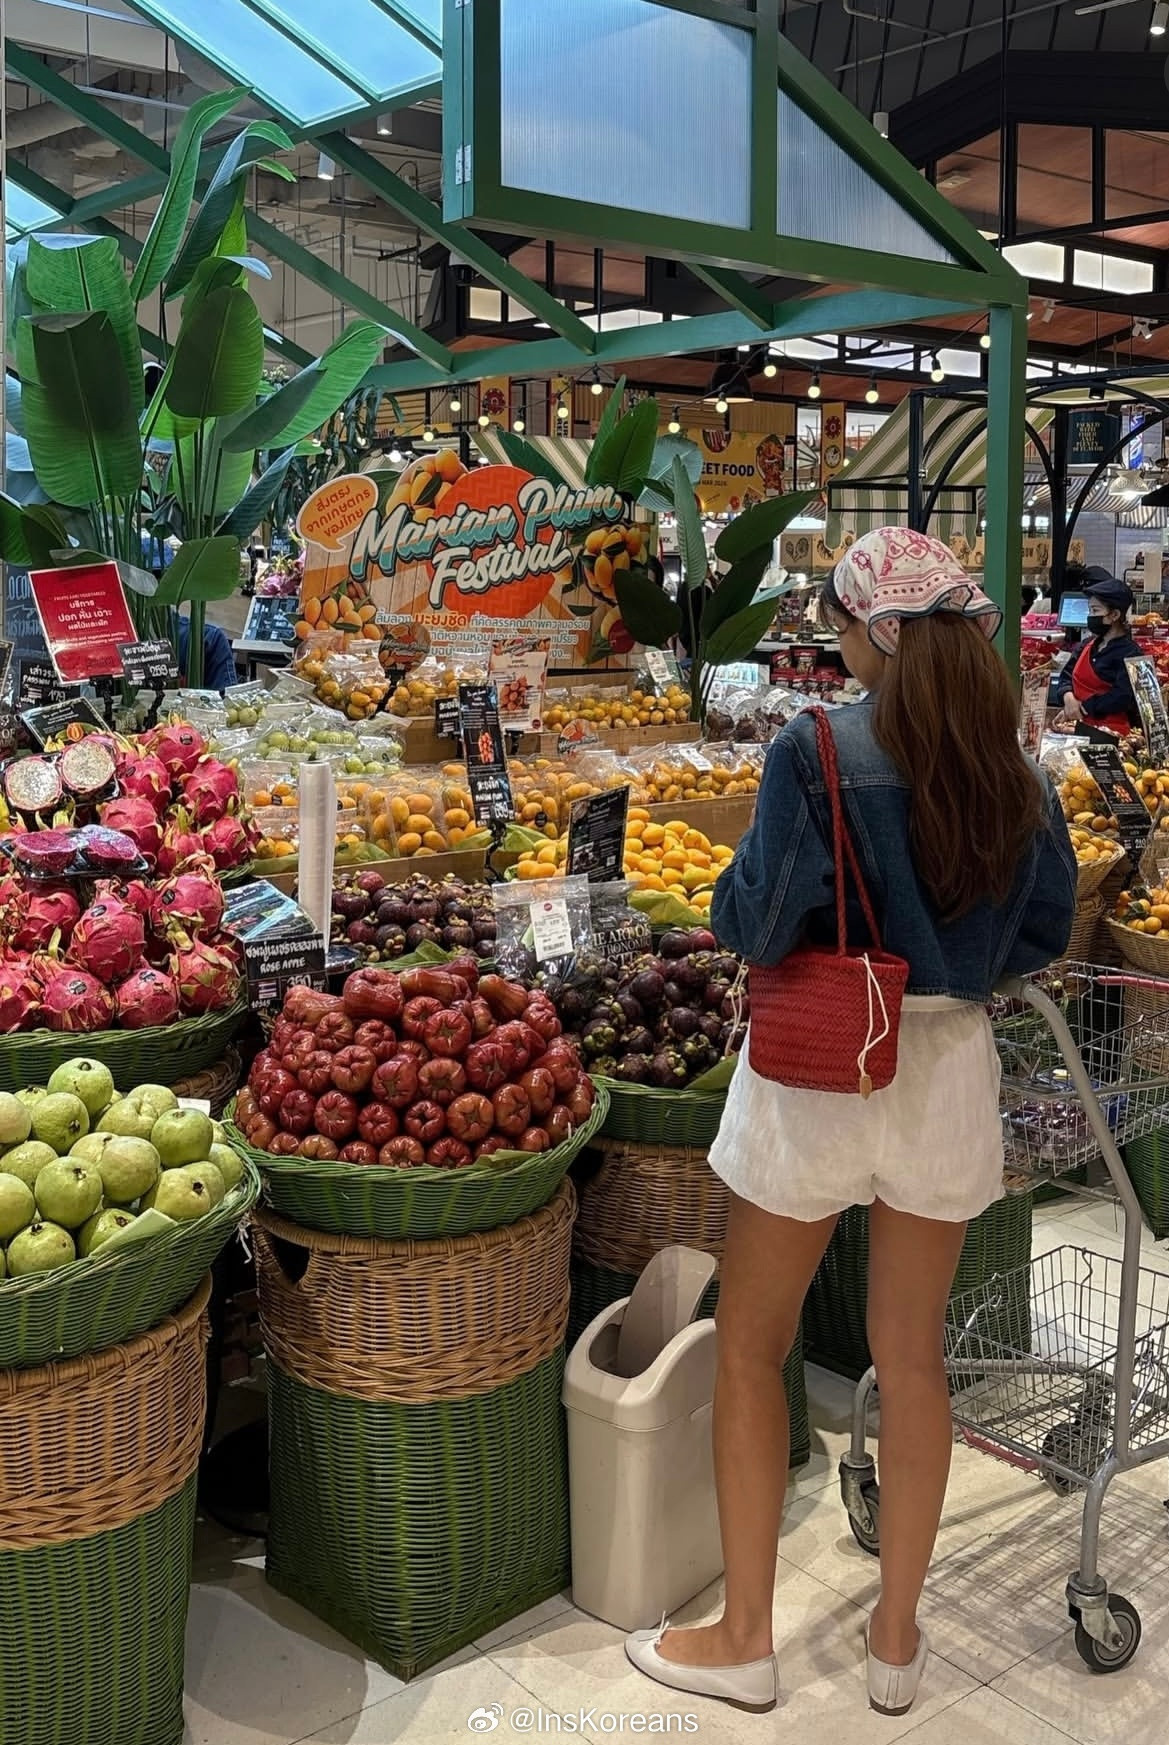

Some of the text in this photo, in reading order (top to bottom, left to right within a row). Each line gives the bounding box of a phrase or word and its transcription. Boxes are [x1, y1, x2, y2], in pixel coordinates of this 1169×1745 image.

[722, 463, 755, 477] FOOD
[350, 477, 625, 582] Marian Plum
[428, 531, 577, 610] Festival
[58, 612, 78, 622] ปอก
[415, 612, 467, 627] มะยงชิด
[260, 956, 306, 974] ROSE APPLE
